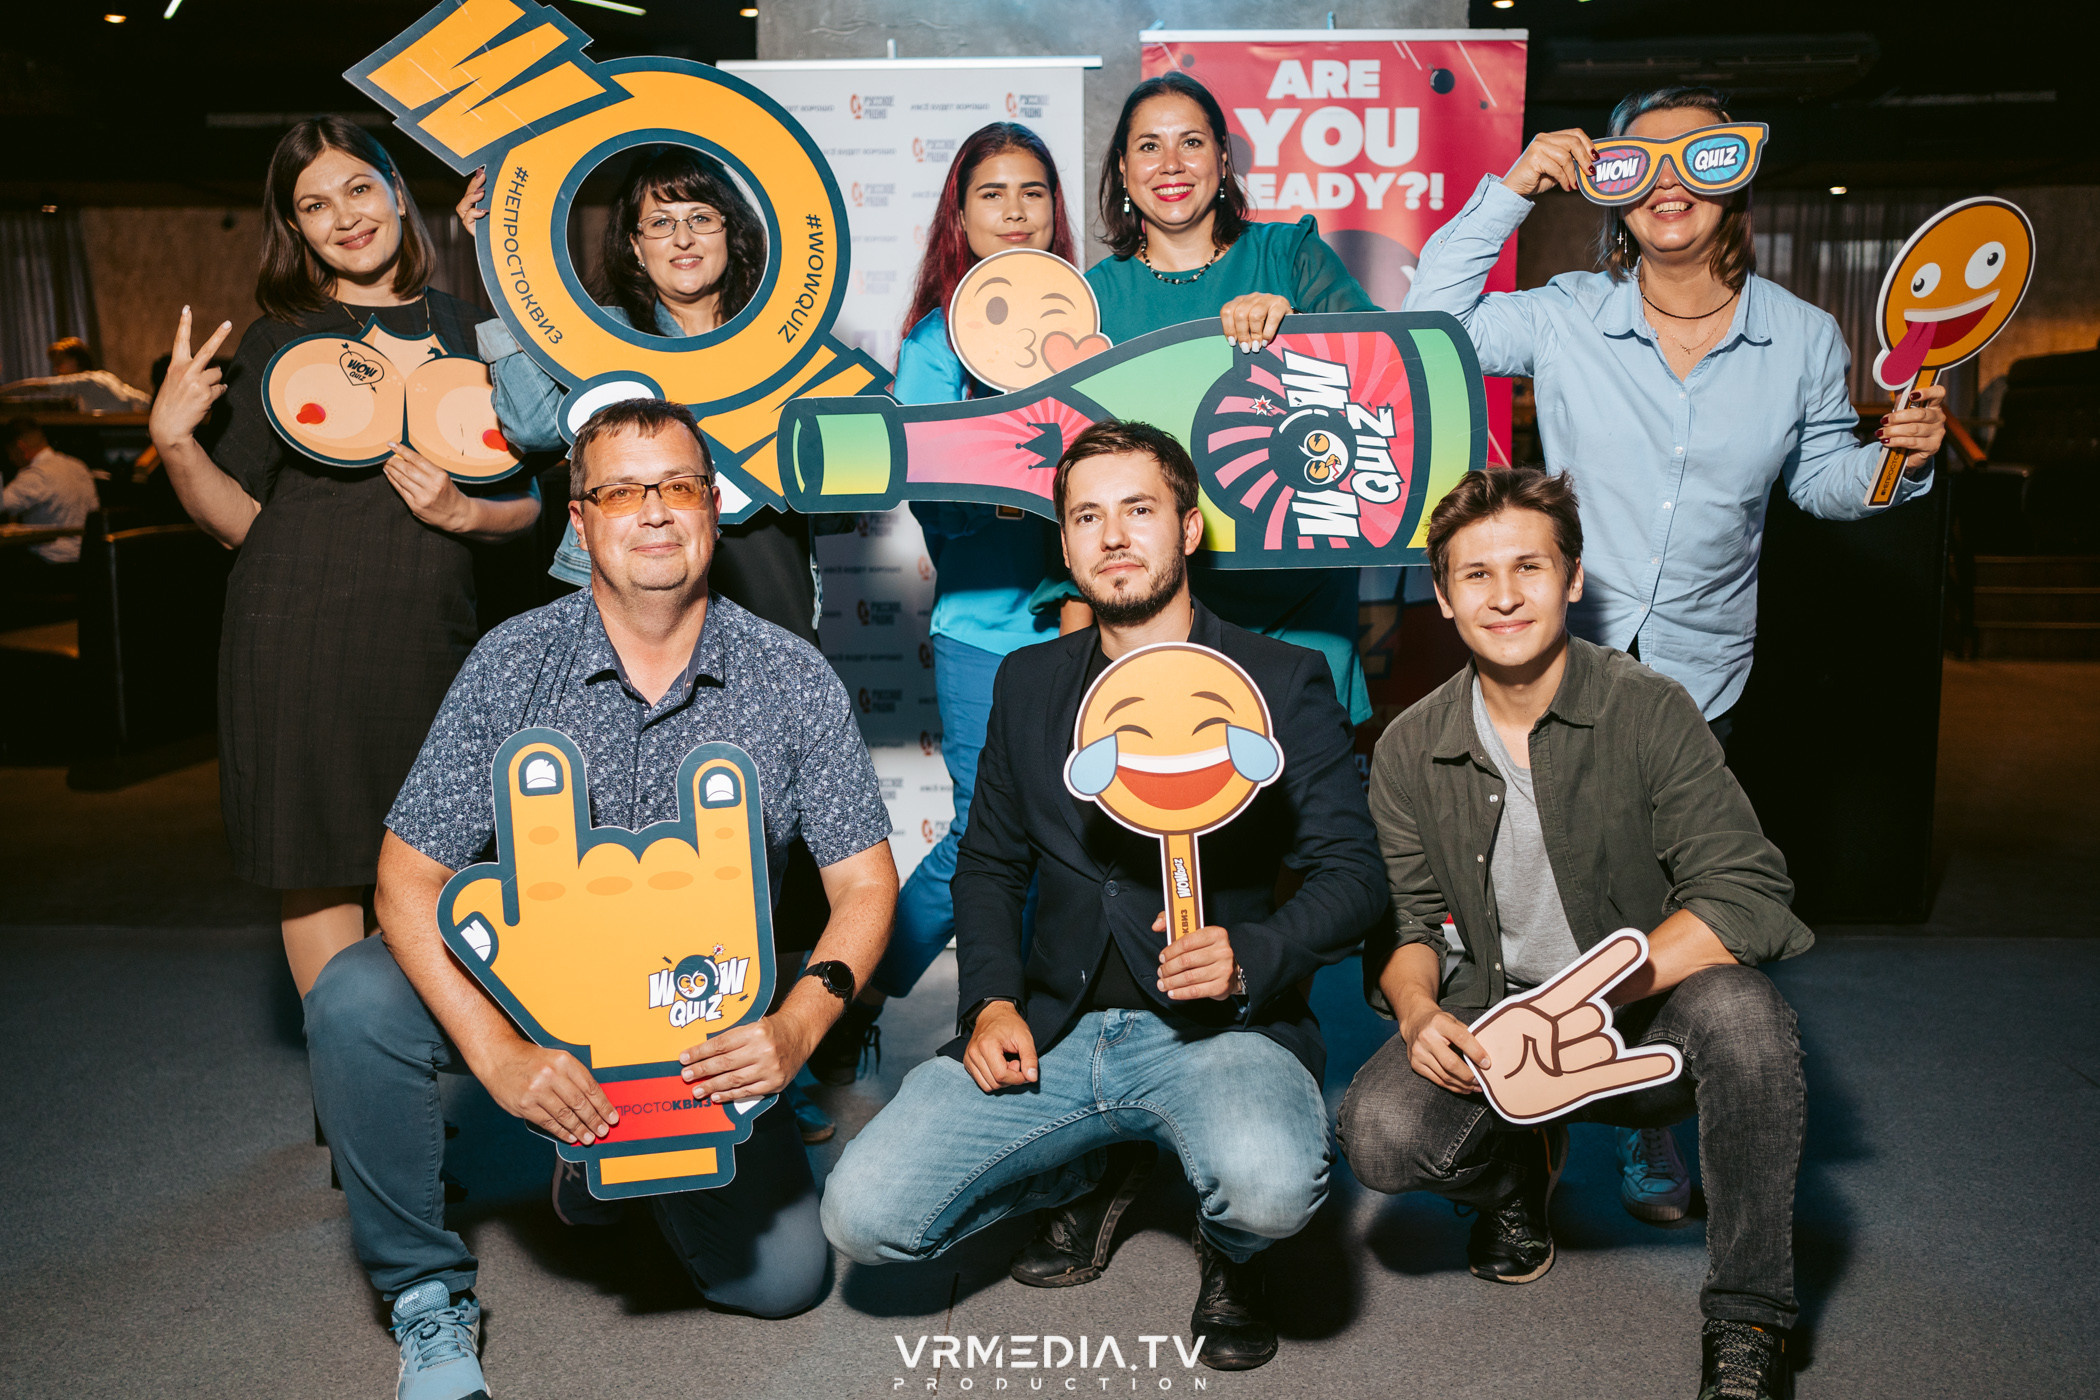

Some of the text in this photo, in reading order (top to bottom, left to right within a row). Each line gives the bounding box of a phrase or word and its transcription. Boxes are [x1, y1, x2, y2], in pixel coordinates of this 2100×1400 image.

[1266, 60, 1381, 99] ARE
[1233, 106, 1420, 167] YOU
[1596, 145, 1738, 183] WOW QUIZ
[503, 166, 563, 344] #НЕПРОСТОКВИЗ
[777, 213, 824, 343] #WOWQUIZ
[347, 359, 378, 377] WOW
[349, 371, 366, 381] QUIZ
[1350, 402, 1403, 505] QUIZ
[648, 957, 750, 1009] WOW
[669, 994, 724, 1028] QUIZ
